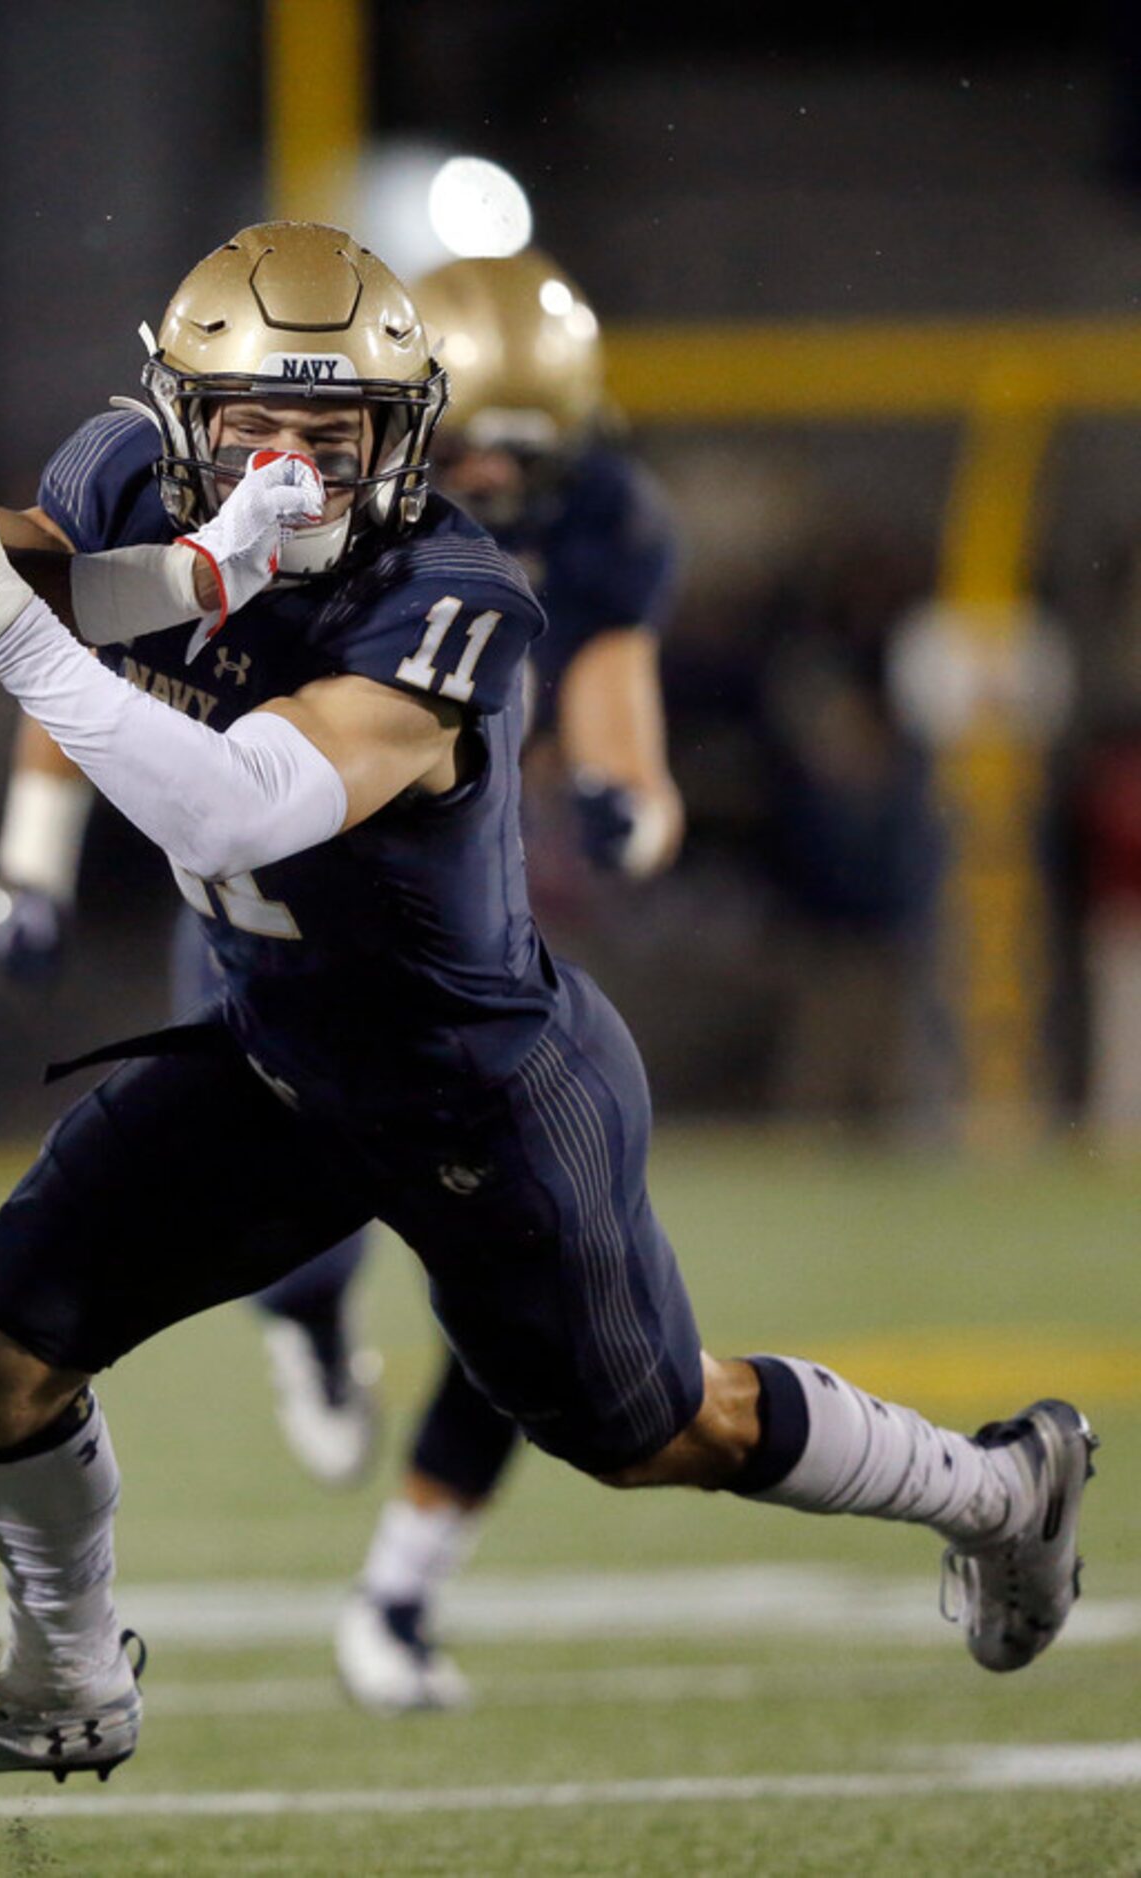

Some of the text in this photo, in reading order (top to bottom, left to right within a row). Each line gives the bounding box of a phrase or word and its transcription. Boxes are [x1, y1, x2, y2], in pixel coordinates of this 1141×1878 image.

[281, 358, 338, 380] NAVY
[395, 595, 503, 703] 11
[124, 656, 219, 723] NAVY
